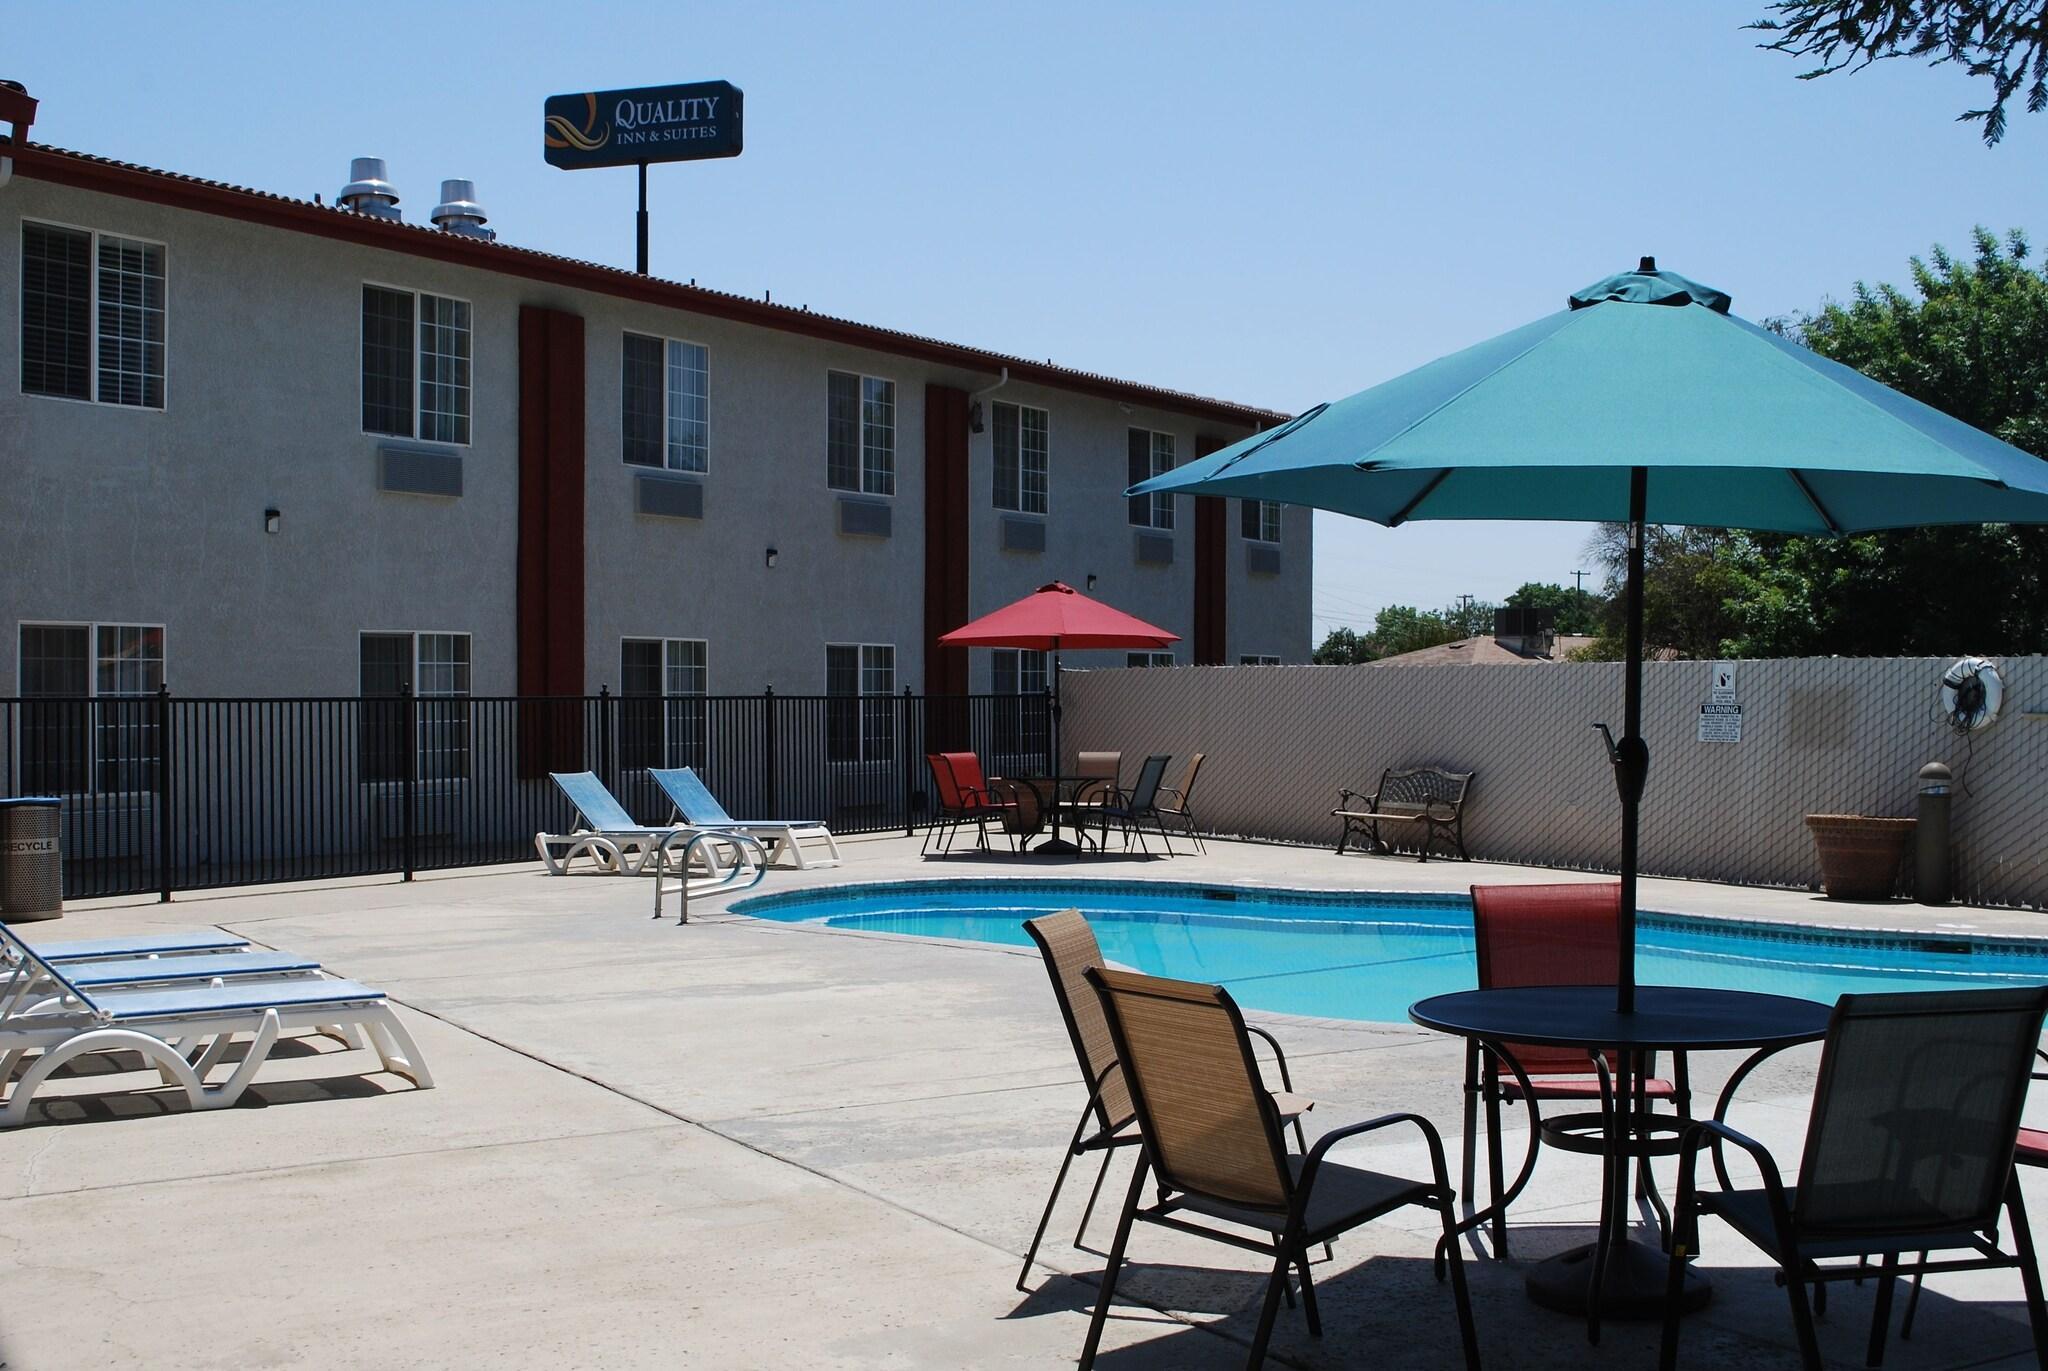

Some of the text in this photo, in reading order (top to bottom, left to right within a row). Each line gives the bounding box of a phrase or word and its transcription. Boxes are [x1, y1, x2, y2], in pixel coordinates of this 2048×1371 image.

[615, 96, 720, 129] QUALITY
[617, 125, 717, 145] INN & SUITES
[1704, 705, 1739, 714] WARNING
